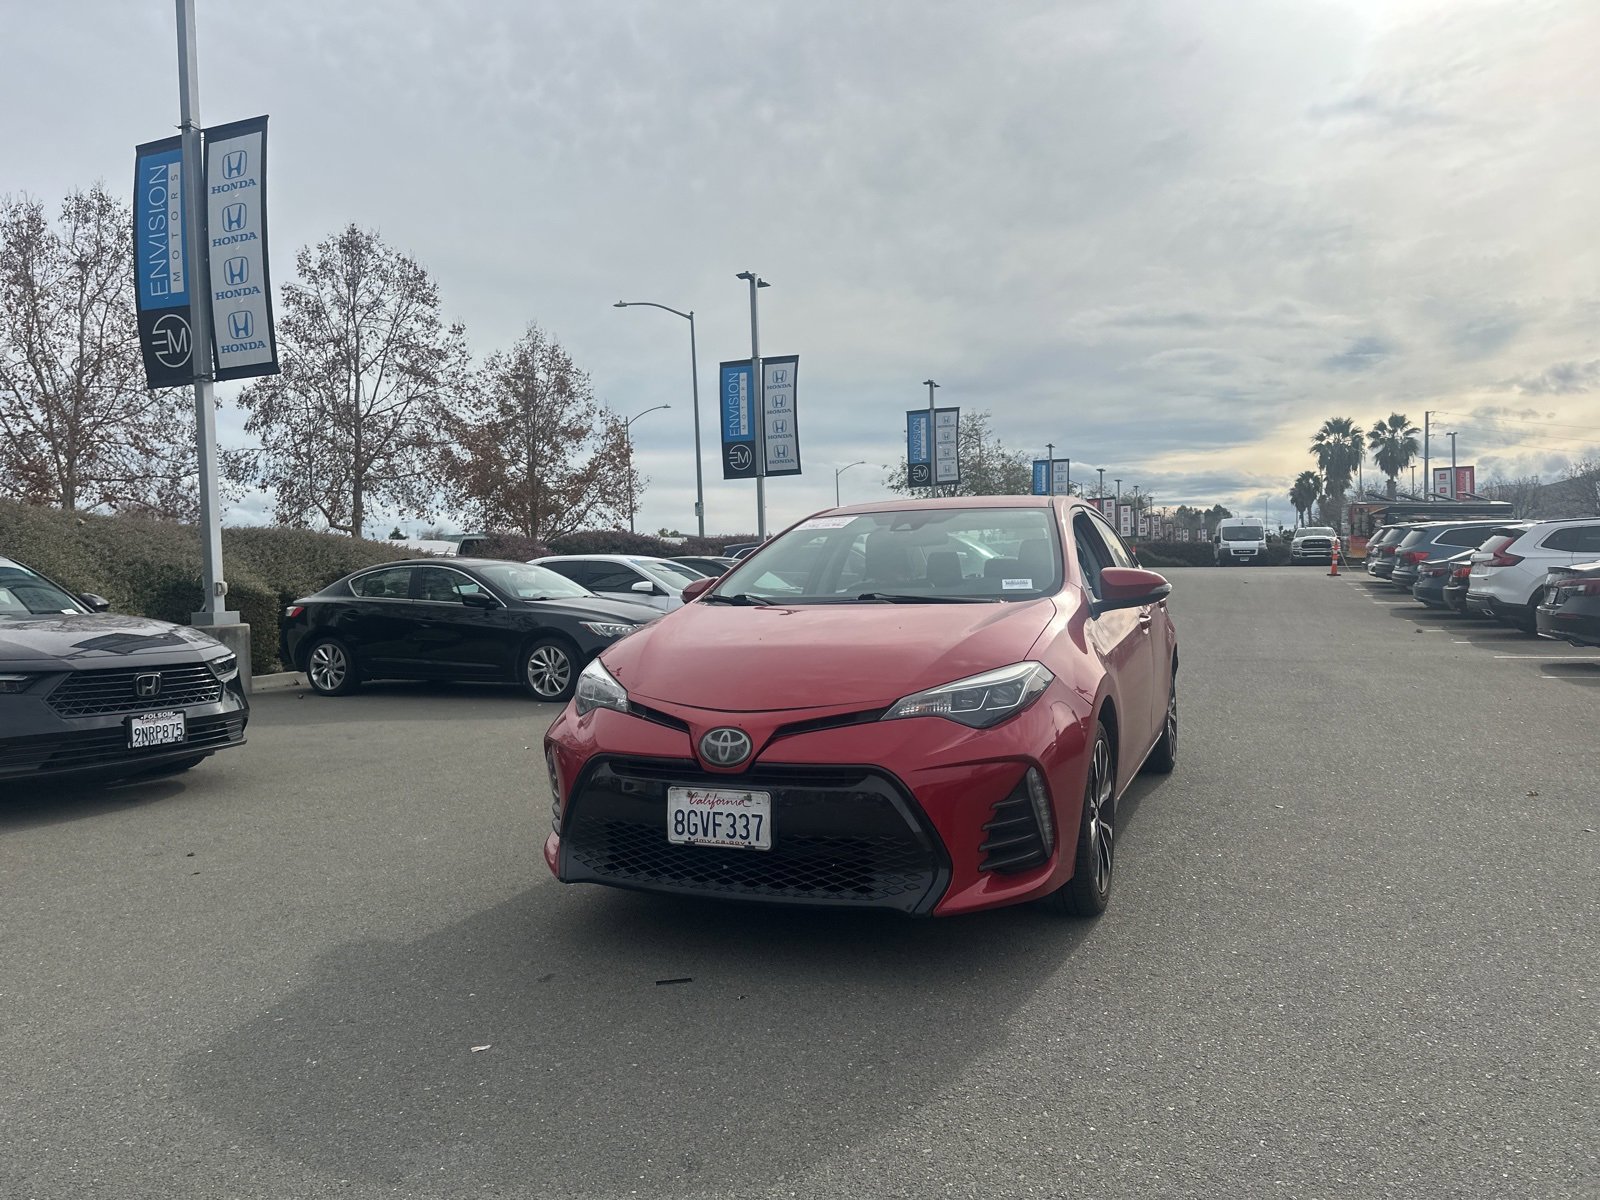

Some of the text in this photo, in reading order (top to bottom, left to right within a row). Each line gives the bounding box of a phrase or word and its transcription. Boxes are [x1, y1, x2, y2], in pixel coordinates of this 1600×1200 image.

[211, 178, 257, 194] HONDA
[149, 164, 169, 297] ENVISION
[171, 174, 182, 283] MOTORS
[212, 231, 258, 247] HONDA
[215, 286, 261, 300] HONDA
[221, 340, 266, 354] HONDA
[729, 372, 739, 436] ENVISION
[913, 418, 921, 460] ENVISION
[134, 723, 183, 742] 9NRP875
[689, 791, 751, 809] California
[674, 809, 763, 841] 8GVF337
